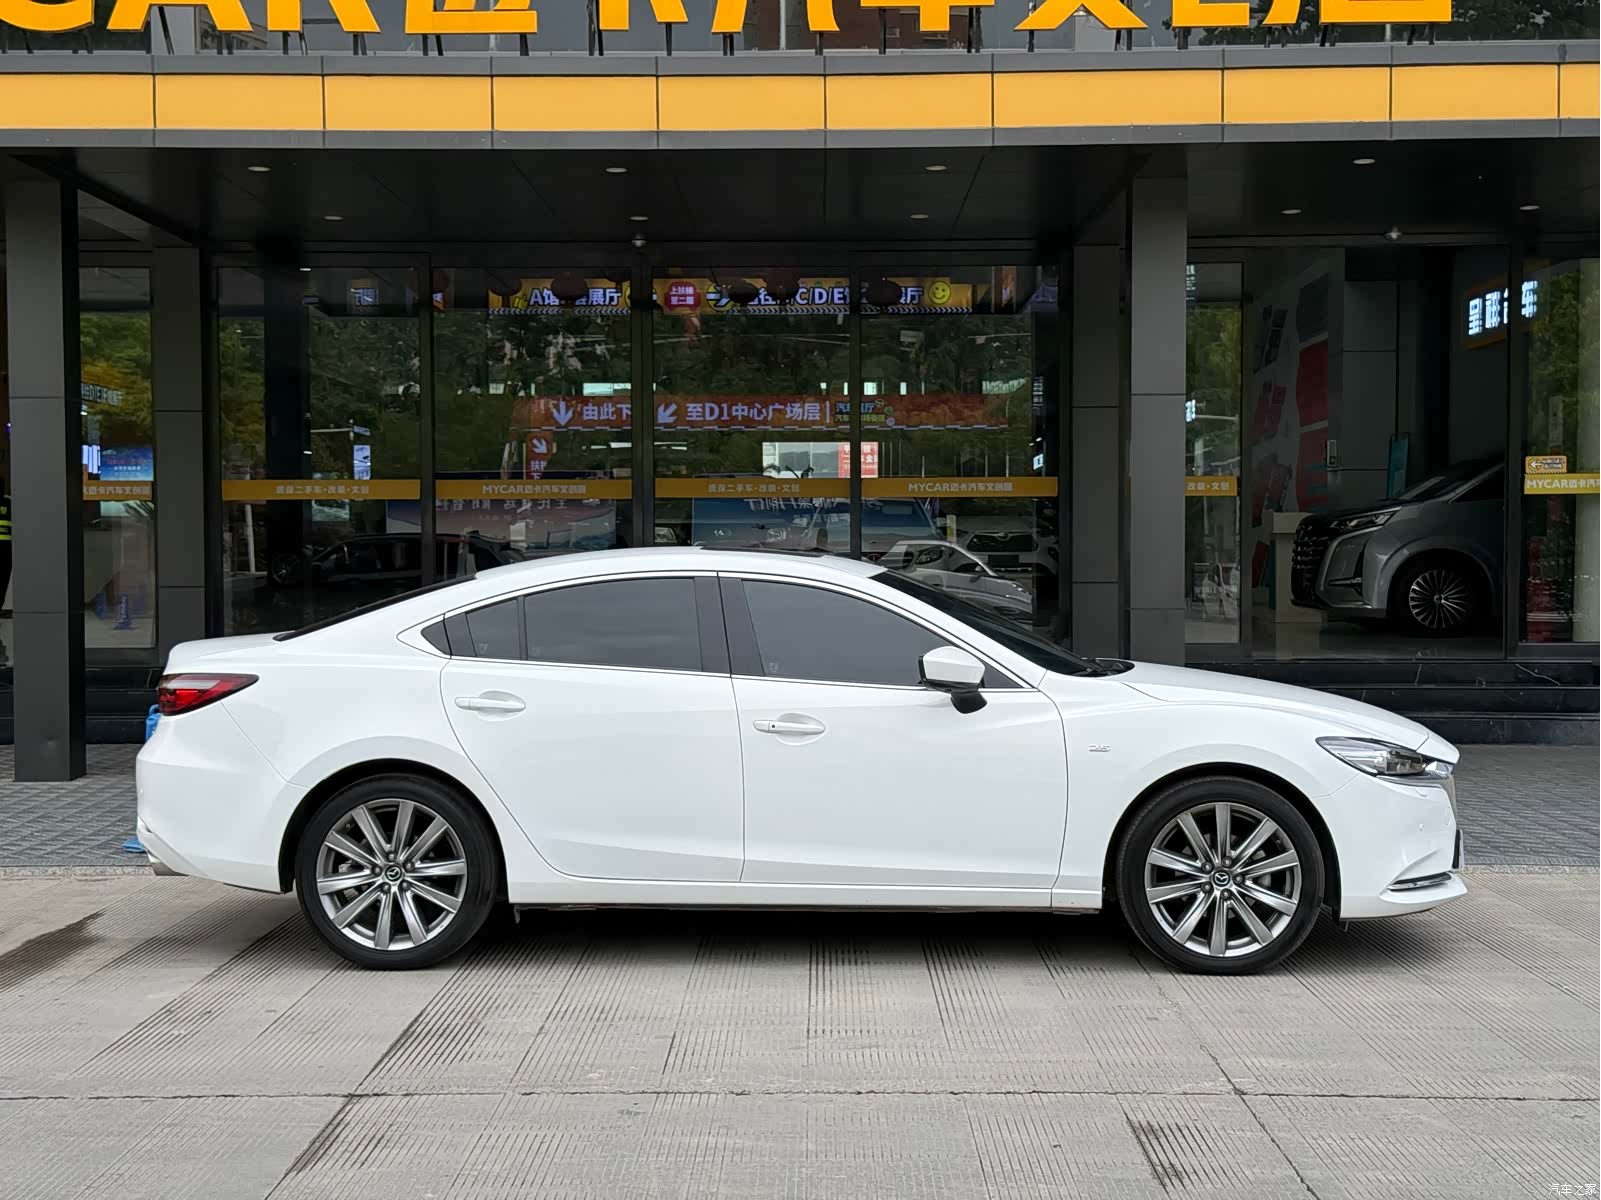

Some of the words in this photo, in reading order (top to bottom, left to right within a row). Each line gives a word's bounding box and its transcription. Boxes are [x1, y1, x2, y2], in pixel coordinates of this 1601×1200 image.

[685, 402, 821, 422] 至D1中心广场层
